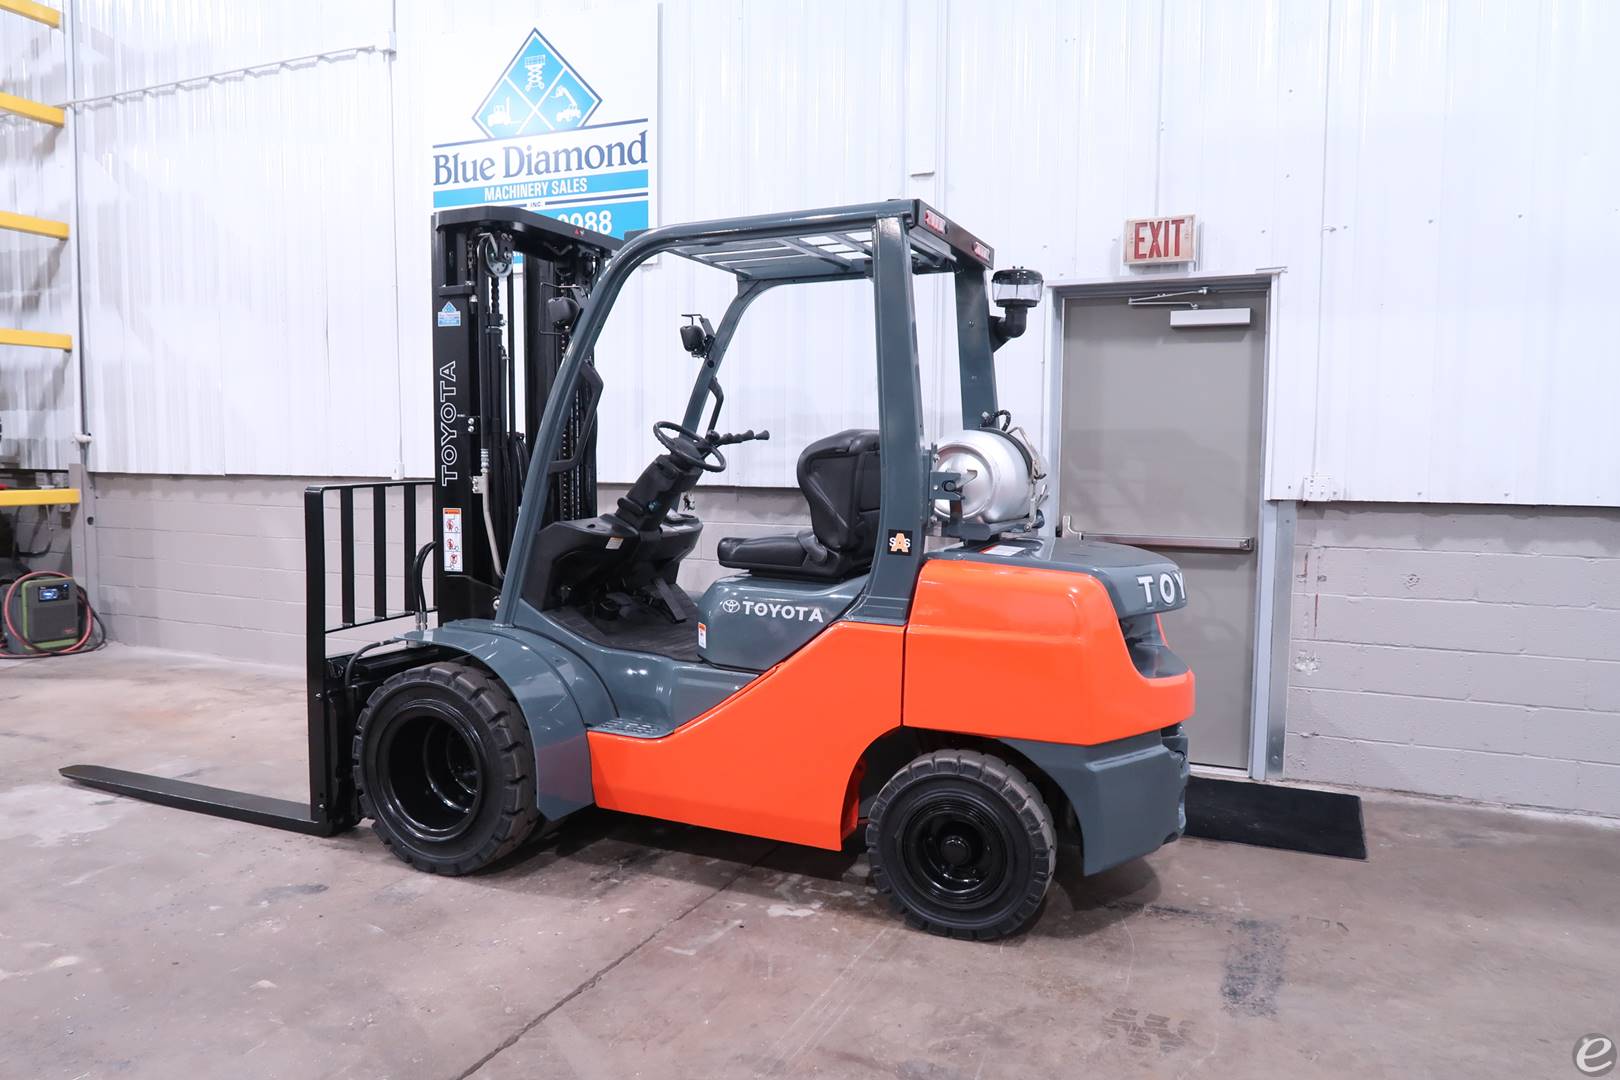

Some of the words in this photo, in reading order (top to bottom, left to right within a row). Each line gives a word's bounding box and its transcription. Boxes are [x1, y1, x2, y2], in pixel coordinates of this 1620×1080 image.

[433, 153, 495, 186] Blue
[502, 130, 648, 179] Diamond
[484, 180, 549, 201] MACHINERY
[551, 177, 588, 196] SALES
[1134, 219, 1185, 260] EXIT
[440, 360, 458, 487] TOYOTA
[742, 601, 824, 623] TOYOTA
